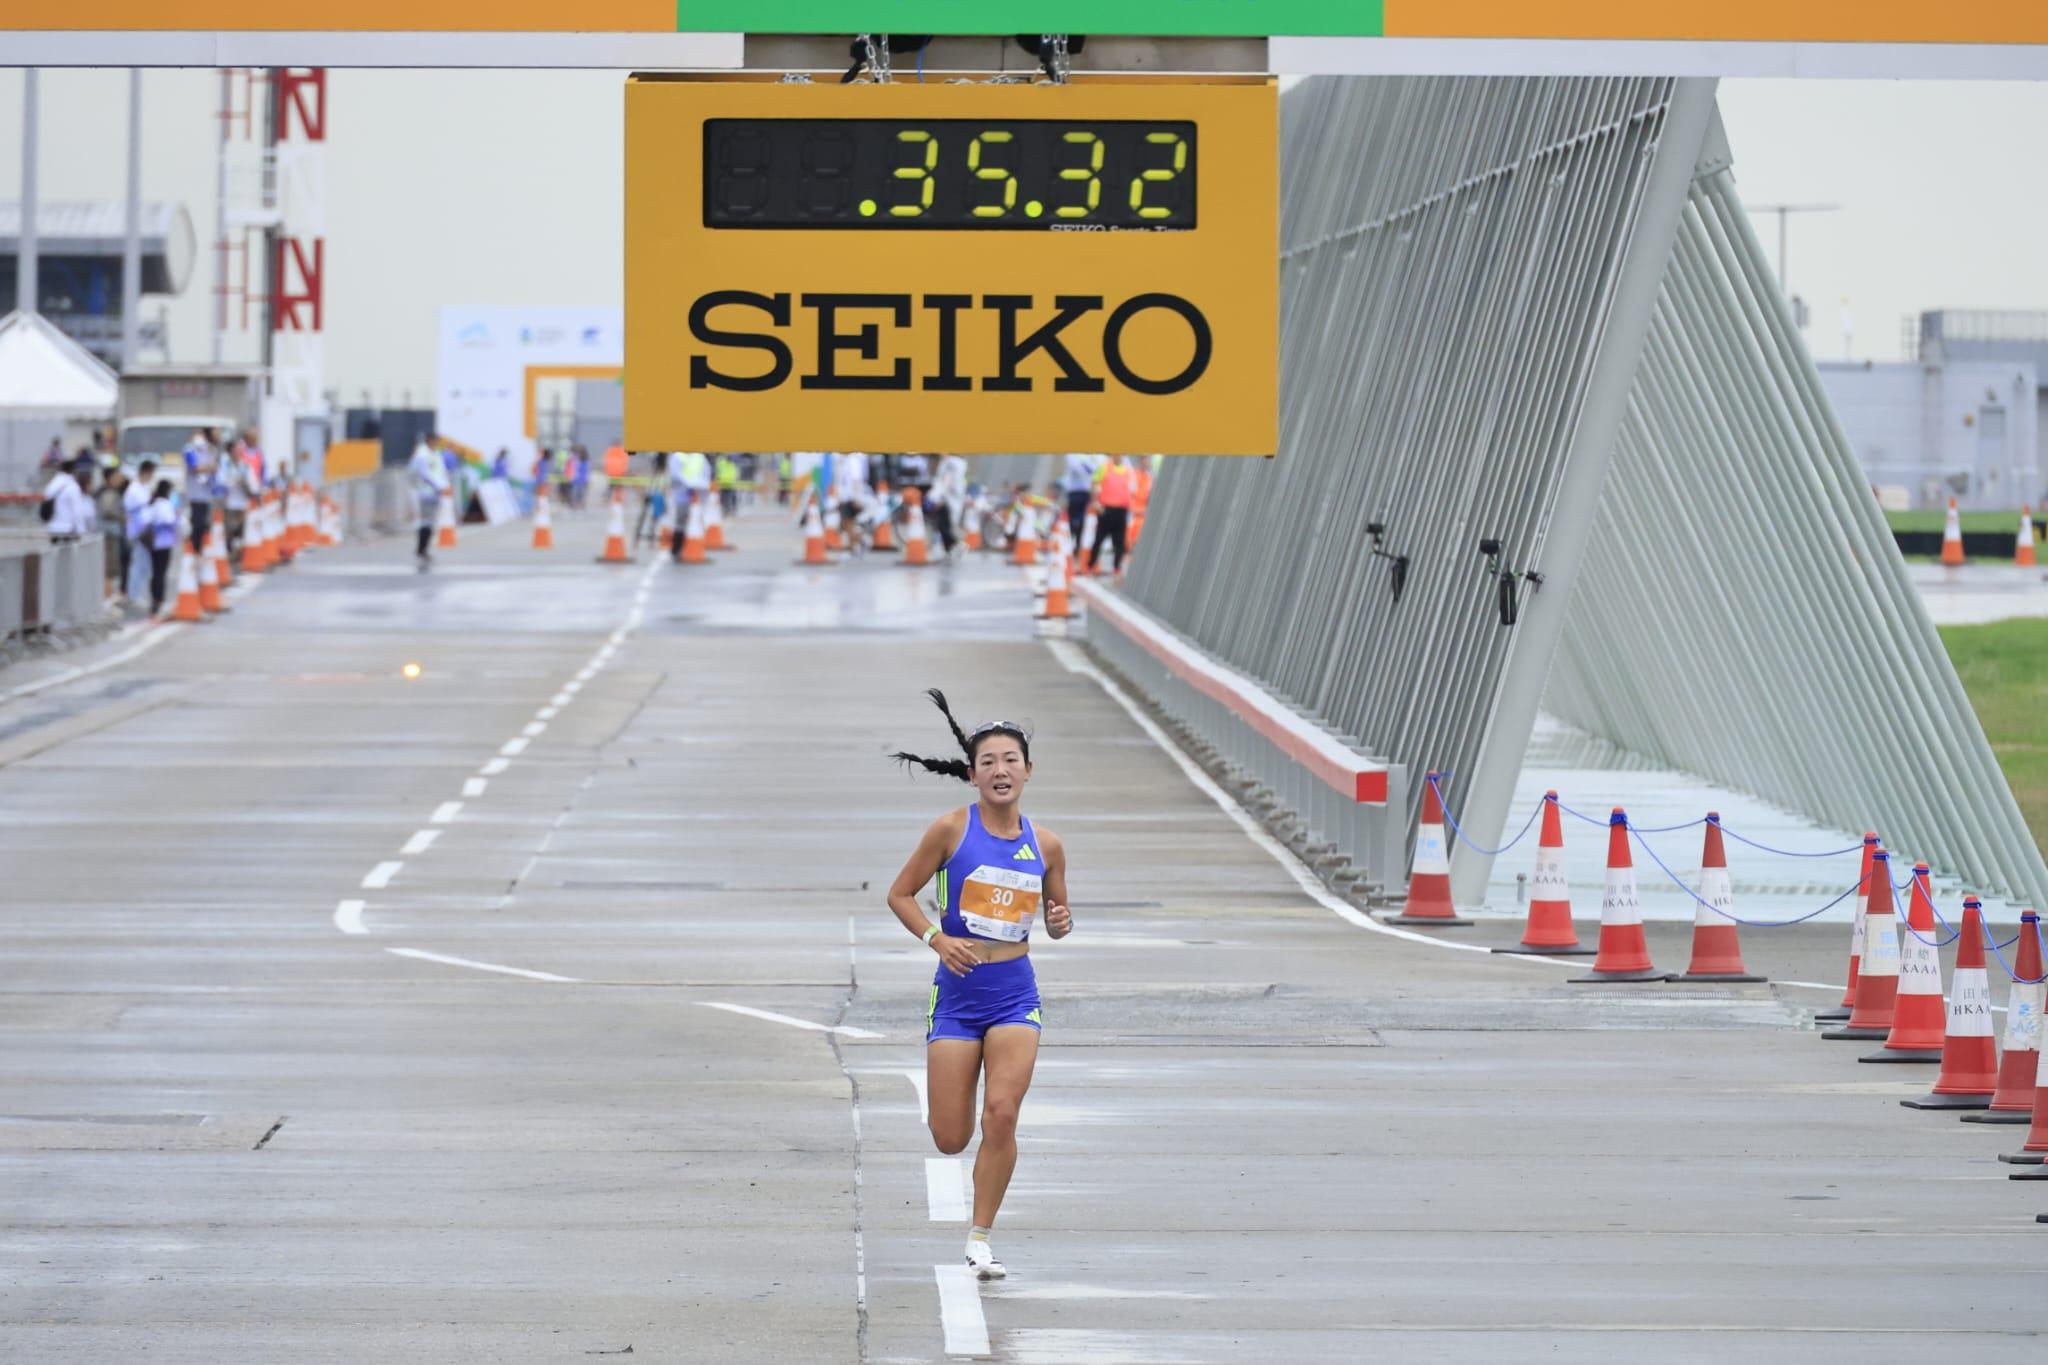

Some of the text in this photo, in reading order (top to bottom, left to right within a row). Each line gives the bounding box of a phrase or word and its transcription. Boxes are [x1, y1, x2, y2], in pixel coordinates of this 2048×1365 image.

[688, 290, 1213, 395] SEIKO
[1533, 876, 1566, 885] KAAA
[991, 887, 1014, 906] 30
[1901, 964, 1937, 976] KAAA
